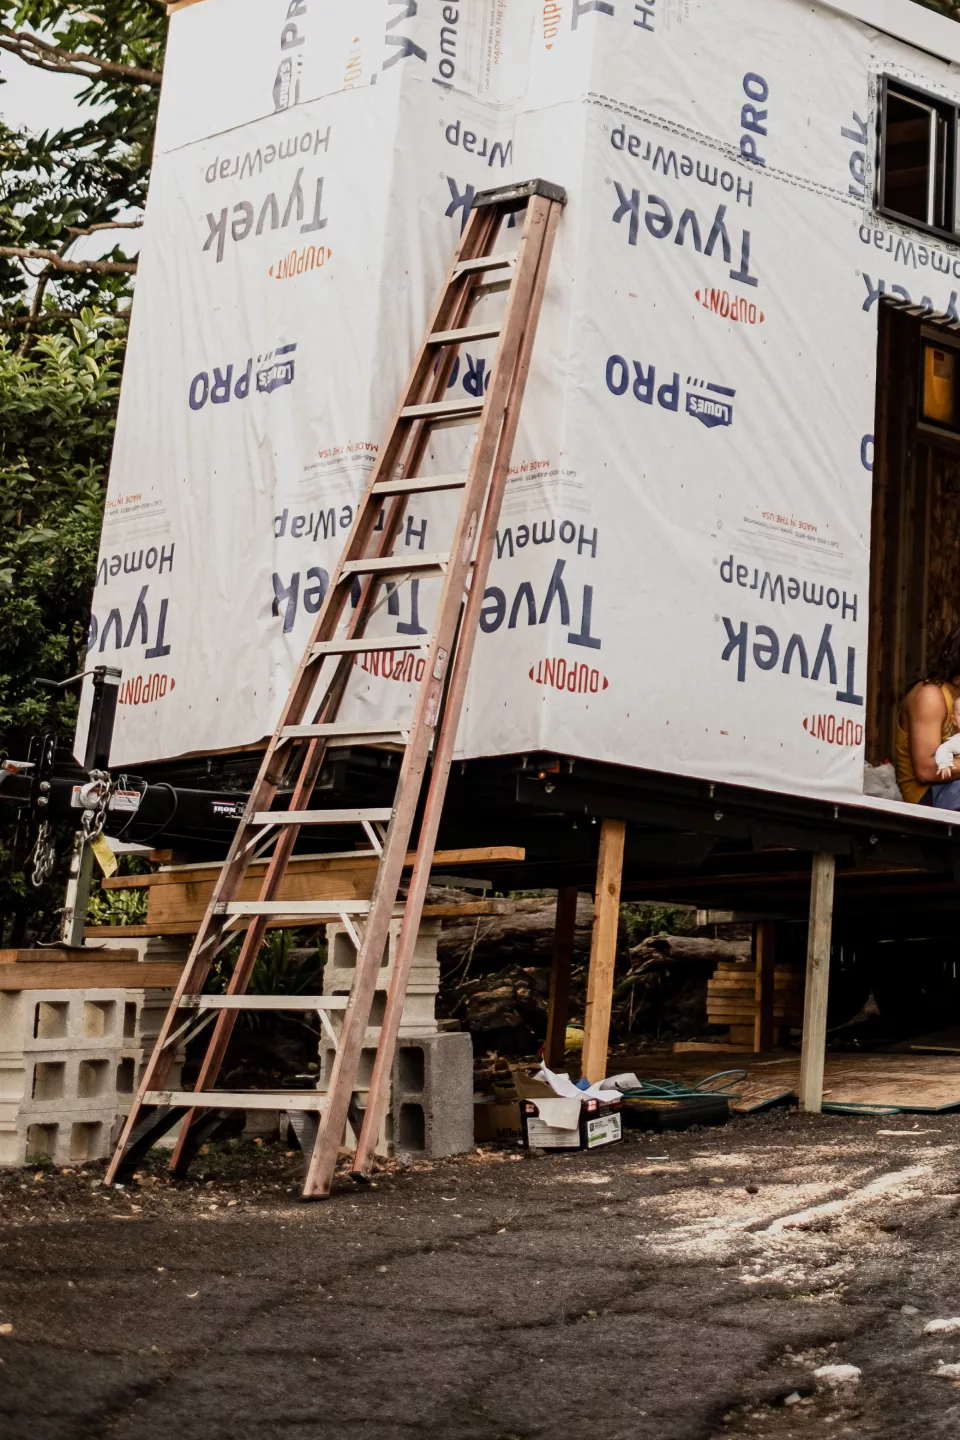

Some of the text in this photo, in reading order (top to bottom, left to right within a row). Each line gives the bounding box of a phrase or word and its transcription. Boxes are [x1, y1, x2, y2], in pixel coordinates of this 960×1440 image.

[445, 120, 513, 168] Wrap
[740, 72, 769, 165] PRO
[205, 126, 331, 184] HomeWrap
[610, 123, 753, 208] HomeWrap
[202, 167, 329, 264] Tyvek
[612, 180, 759, 287] Tyvek
[276, 245, 325, 279] DUPONT
[702, 287, 757, 325] DUPONT
[188, 357, 252, 411] PRO
[605, 353, 680, 412] PRO
[761, 511, 775, 521] USA
[776, 515, 789, 525] THE
[798, 520, 818, 533] MADE
[479, 558, 601, 650] Tyve
[720, 555, 858, 622] HomeWrap
[535, 657, 600, 694] DUPONT
[721, 616, 864, 706] Tyvek
[810, 714, 863, 746] DUPONT
